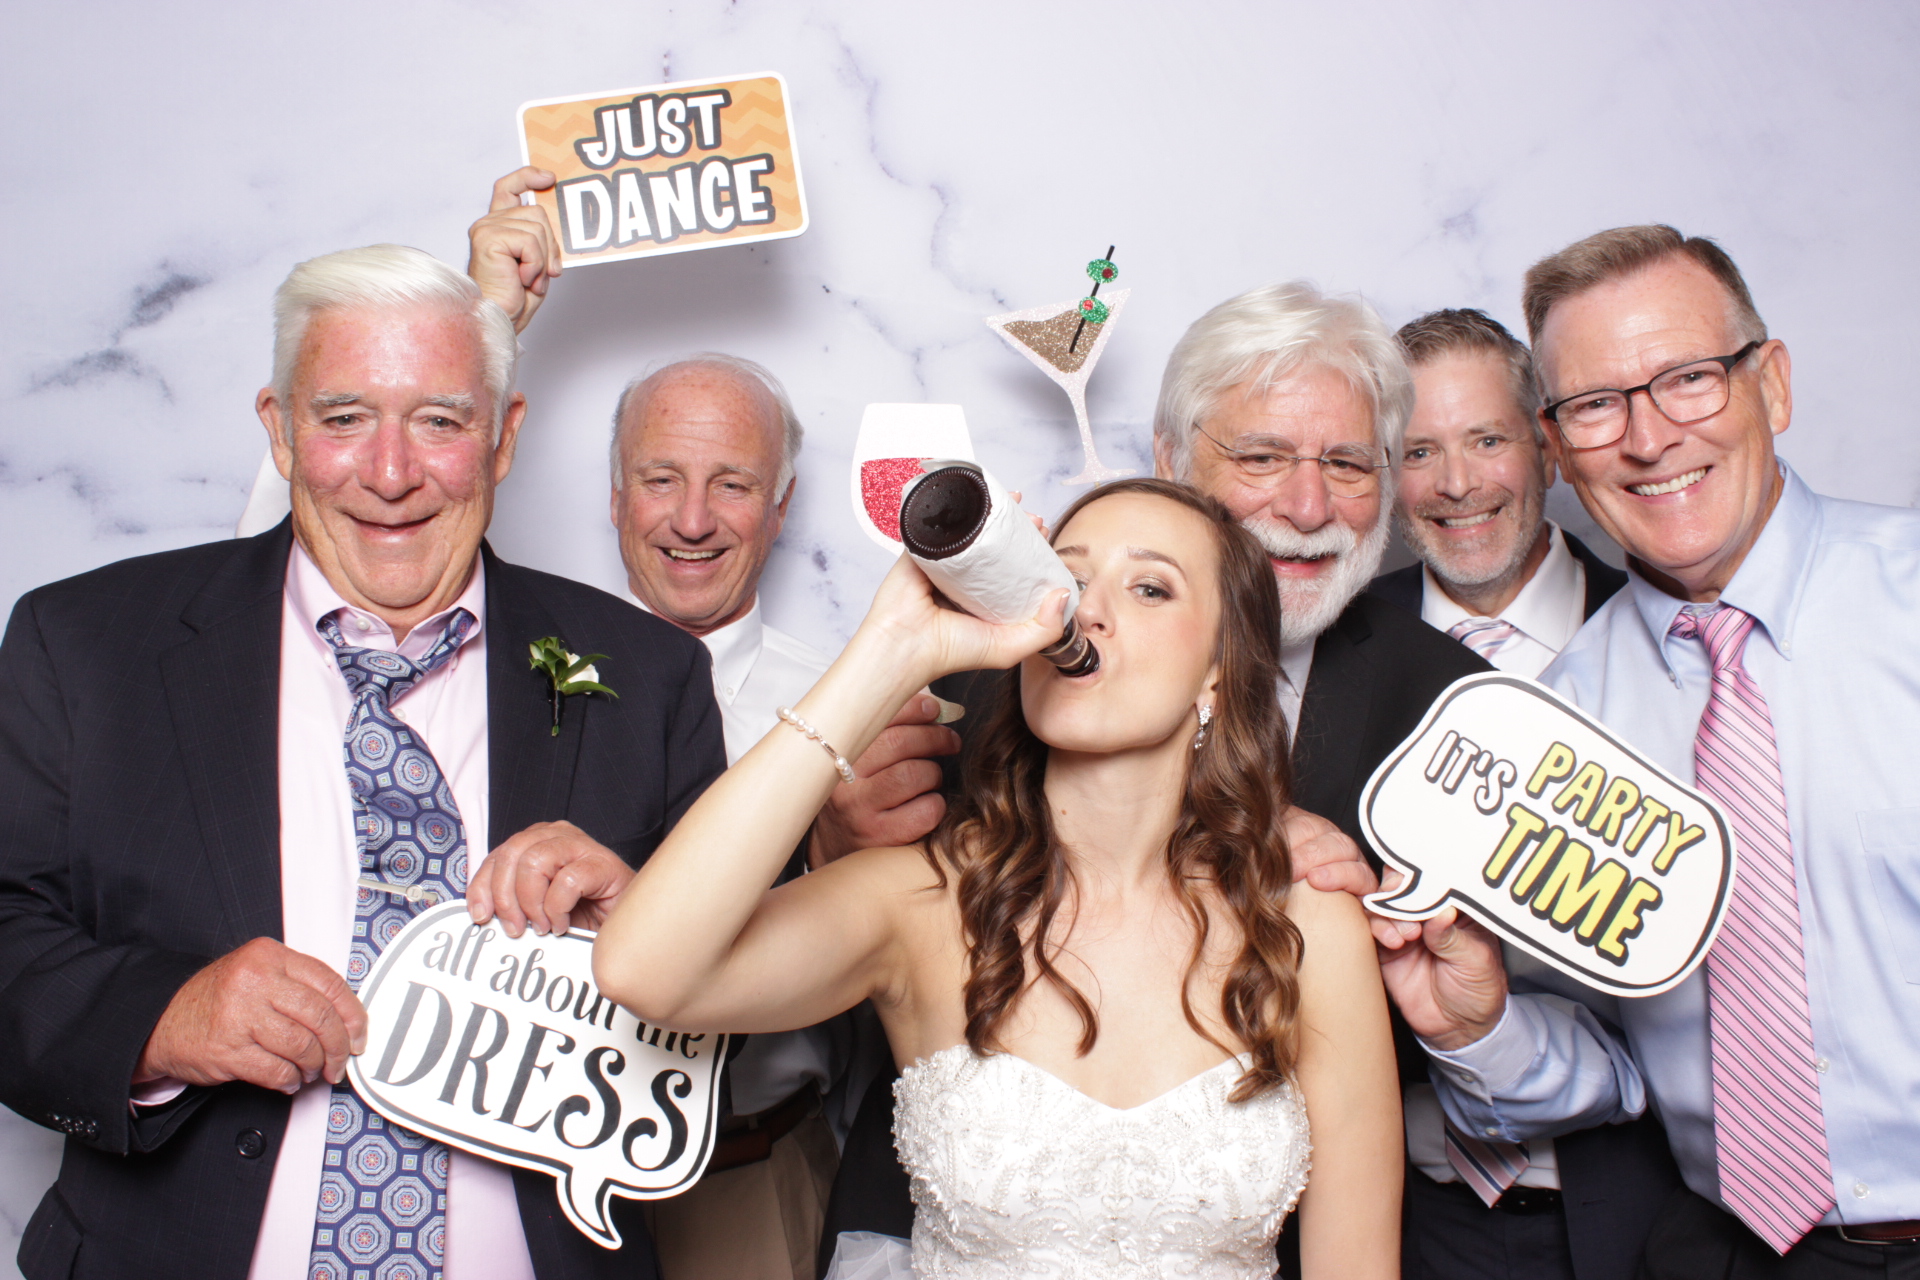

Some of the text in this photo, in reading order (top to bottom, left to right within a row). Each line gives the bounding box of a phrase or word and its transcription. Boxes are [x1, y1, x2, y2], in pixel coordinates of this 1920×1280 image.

[574, 89, 732, 170] JUST
[555, 153, 775, 254] DANCE
[1424, 730, 1706, 876] IT'S PARTY
[1482, 802, 1663, 966] TIME
[423, 923, 496, 981] all
[371, 981, 692, 1171] DRESS
